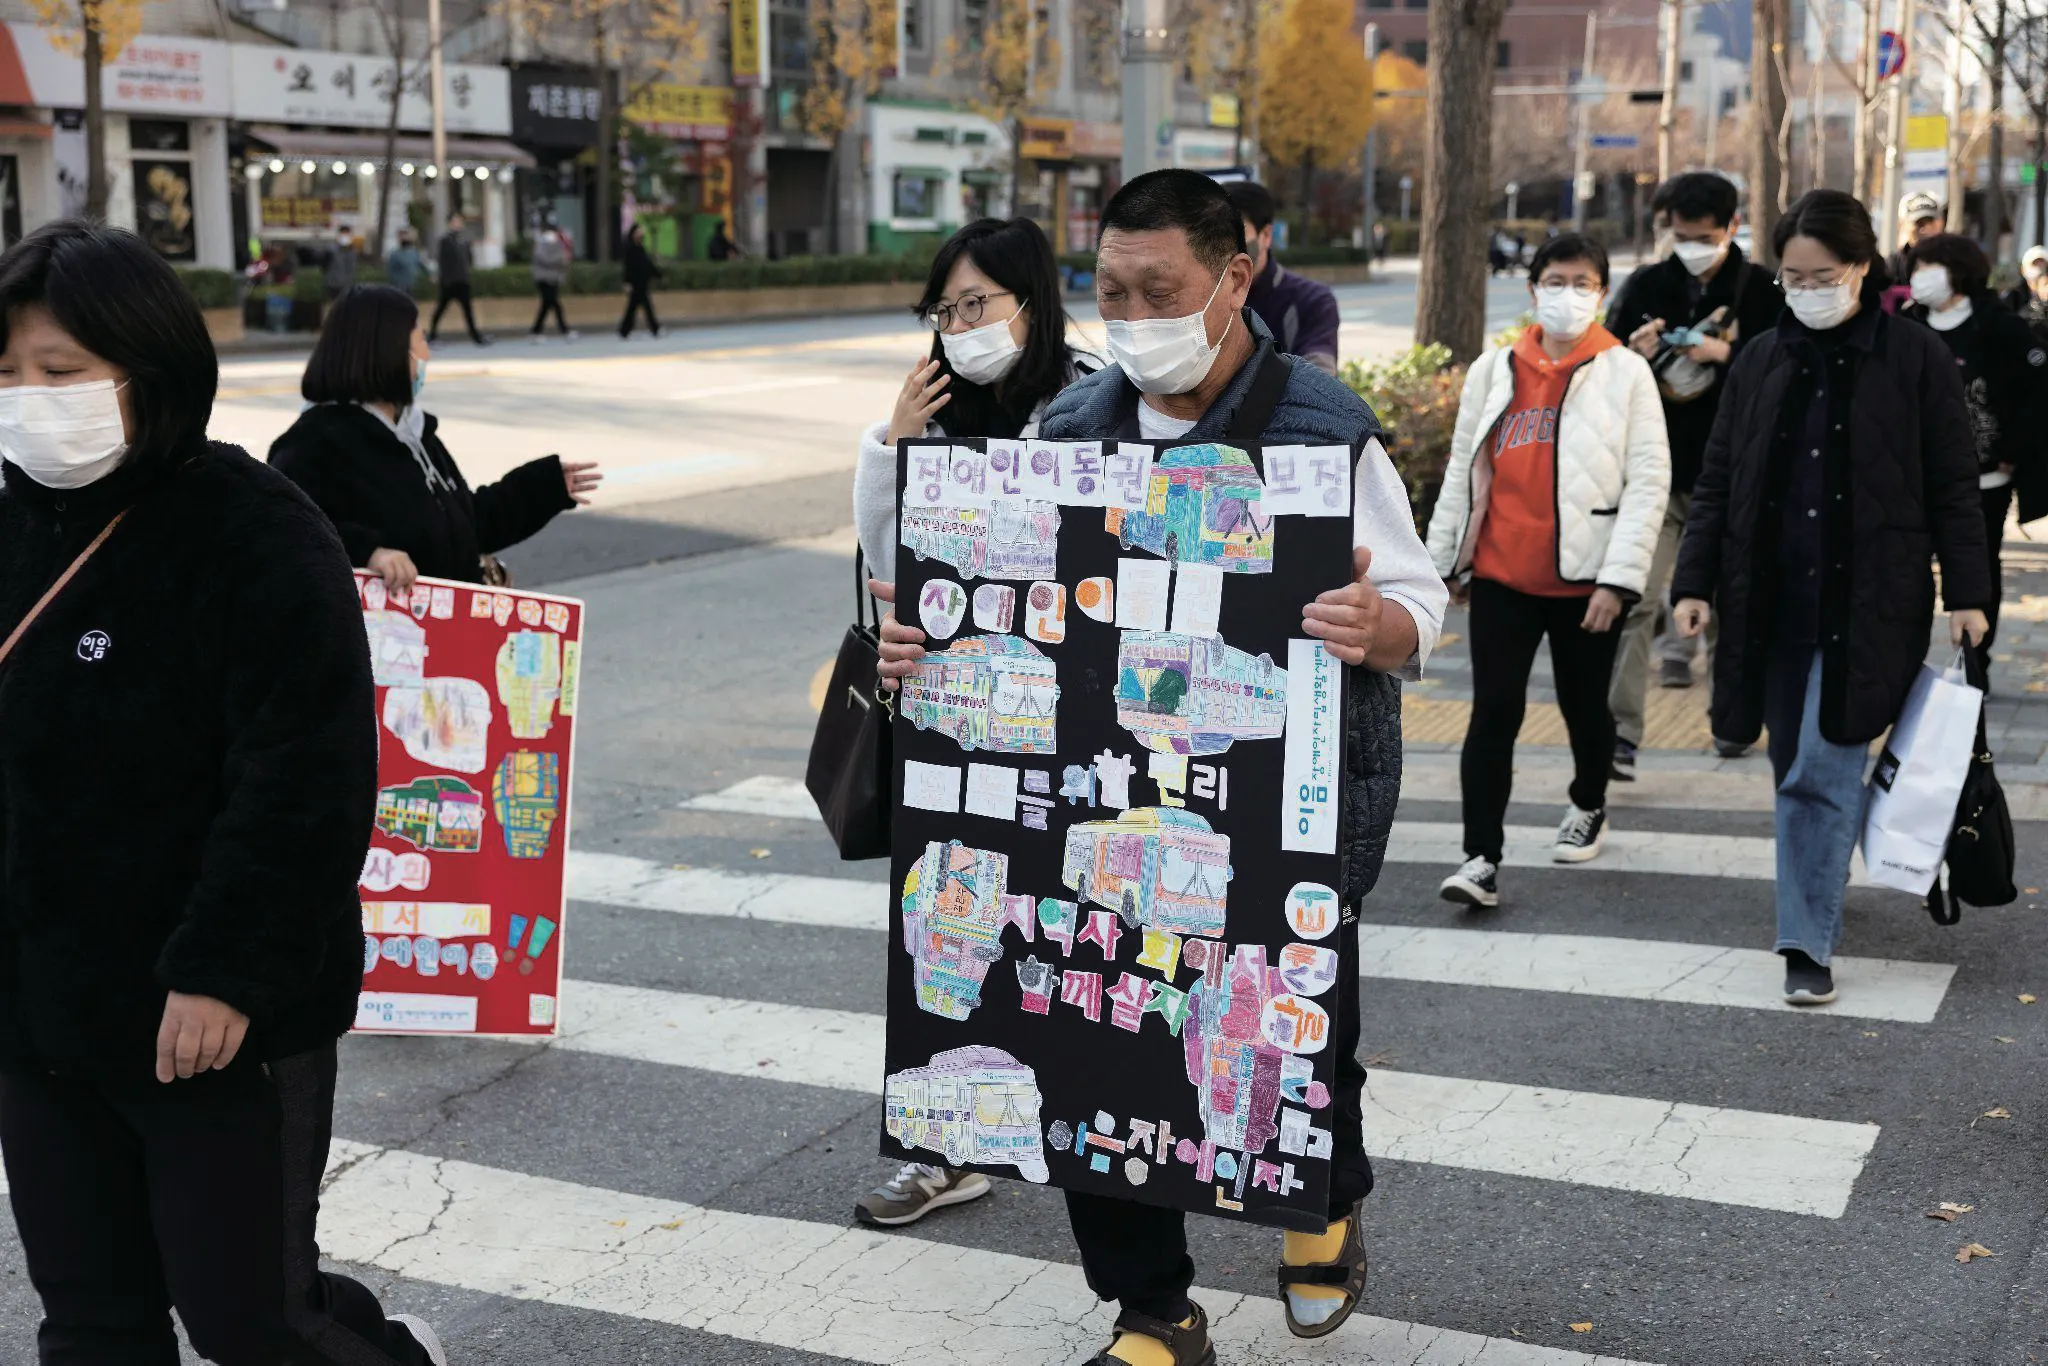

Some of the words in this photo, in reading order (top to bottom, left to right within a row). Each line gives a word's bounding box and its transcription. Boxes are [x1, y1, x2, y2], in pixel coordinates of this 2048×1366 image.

[914, 447, 1145, 505] 장애인이동권
[1269, 455, 1350, 508] 보장
[1311, 645, 1328, 781] 장애인자립생활센터
[1148, 753, 1228, 812] 권리
[1298, 784, 1328, 836] 이음
[1016, 954, 1103, 1023] 함께
[1105, 971, 1193, 1038] 살자
